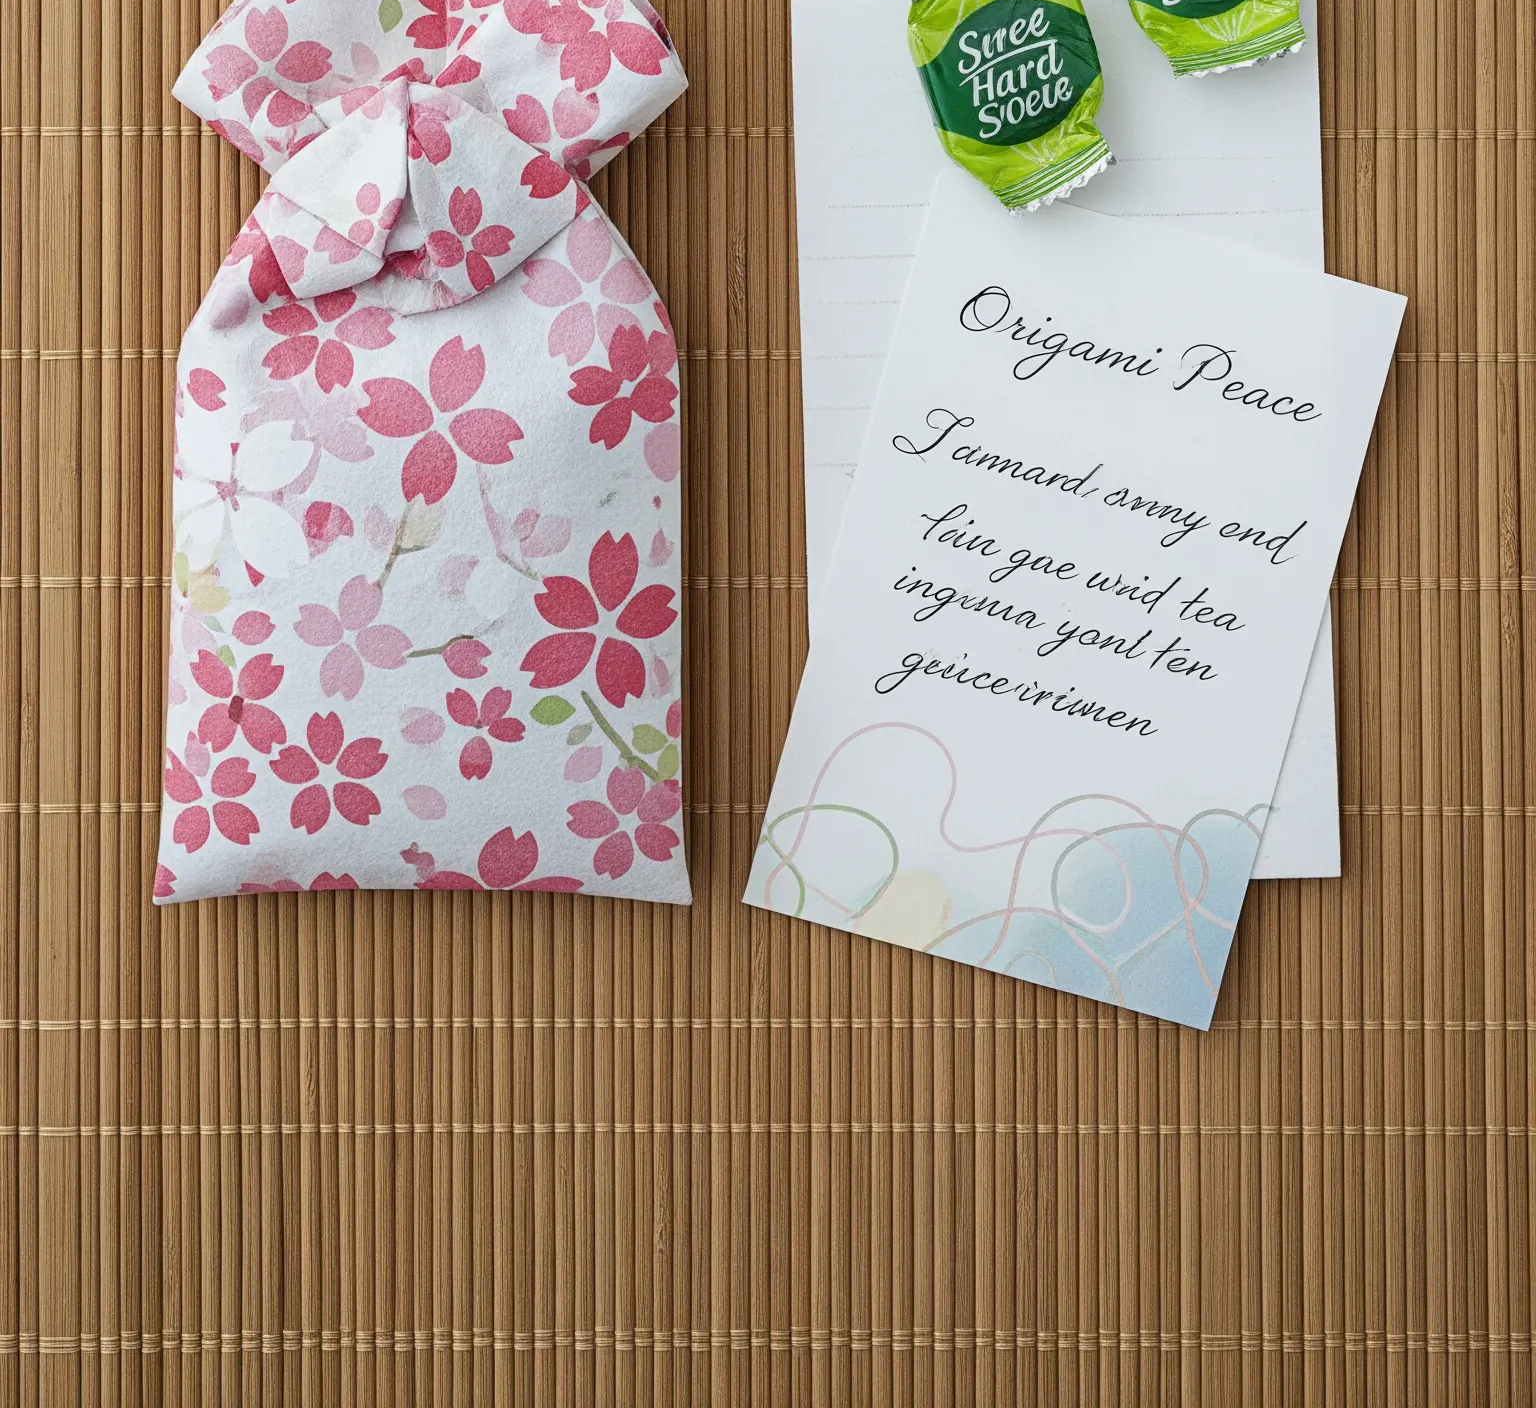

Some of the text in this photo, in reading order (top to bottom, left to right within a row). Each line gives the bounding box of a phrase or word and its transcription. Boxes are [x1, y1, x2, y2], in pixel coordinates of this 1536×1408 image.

[973, 42, 1063, 107] Hard
[959, 285, 1322, 422] Origami Peace
[1179, 587, 1246, 632] tea
[1149, 636, 1219, 681] ten
